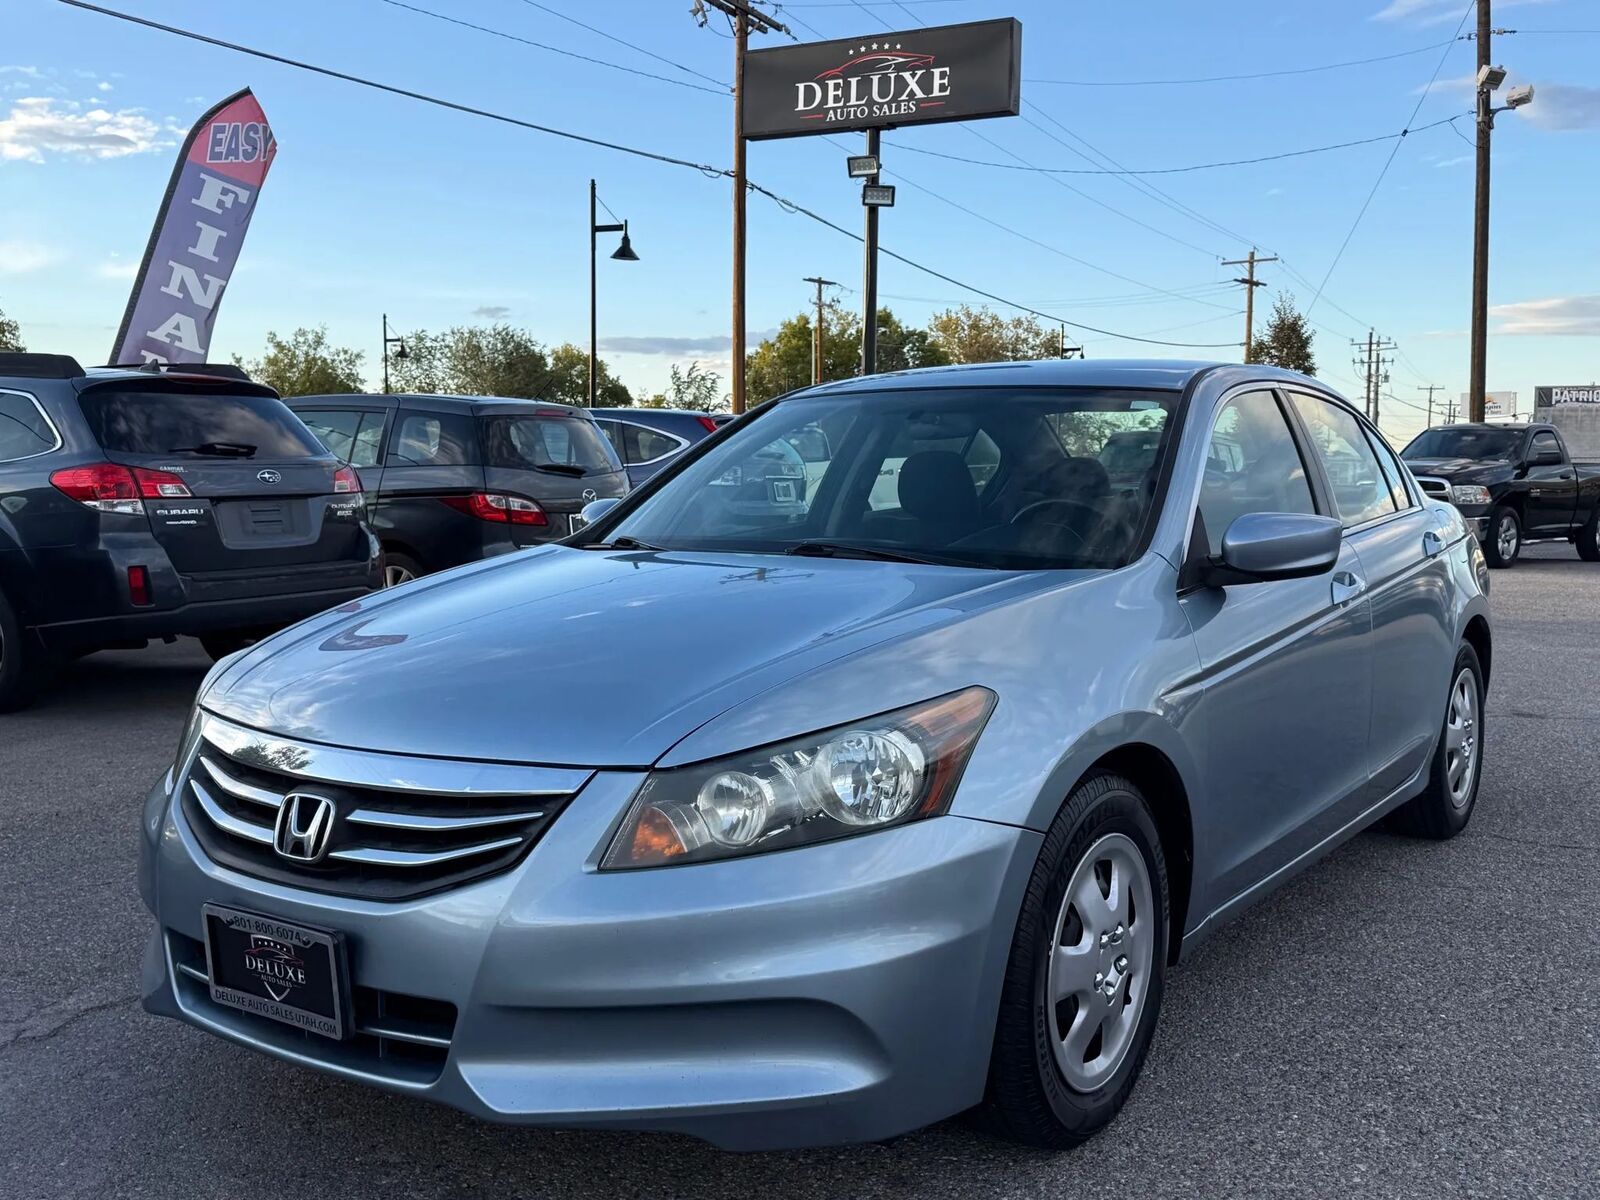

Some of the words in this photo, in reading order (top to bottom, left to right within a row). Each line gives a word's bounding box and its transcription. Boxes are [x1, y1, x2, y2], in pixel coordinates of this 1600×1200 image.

[794, 66, 951, 112] DELUXE
[825, 105, 869, 122] AUTO
[872, 101, 917, 117] SALES
[206, 121, 274, 164] EASY
[156, 508, 204, 516] SUBARU
[245, 954, 306, 984] DELUXE
[261, 973, 276, 983] AUTO
[277, 978, 293, 988] SALES
